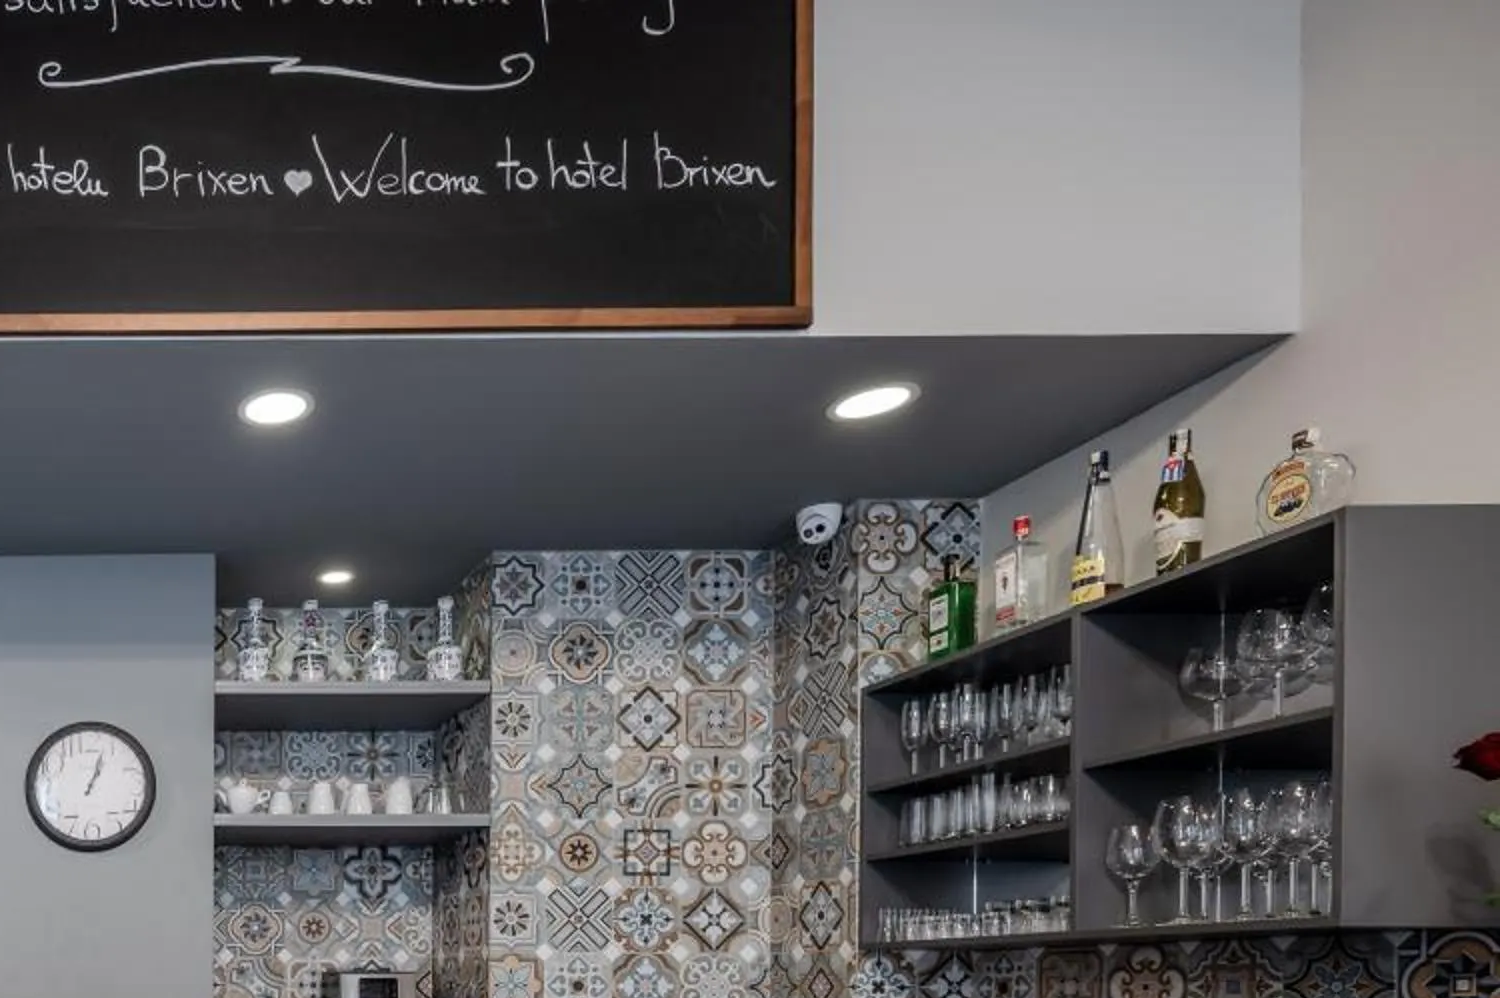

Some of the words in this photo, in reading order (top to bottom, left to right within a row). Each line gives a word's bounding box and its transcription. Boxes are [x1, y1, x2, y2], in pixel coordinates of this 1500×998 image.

[8, 143, 109, 196] hotelu
[138, 145, 274, 198] Brixen
[311, 132, 487, 203] Welcome
[496, 136, 538, 191] to
[547, 138, 628, 191] hotel
[654, 131, 777, 189] Brixen
